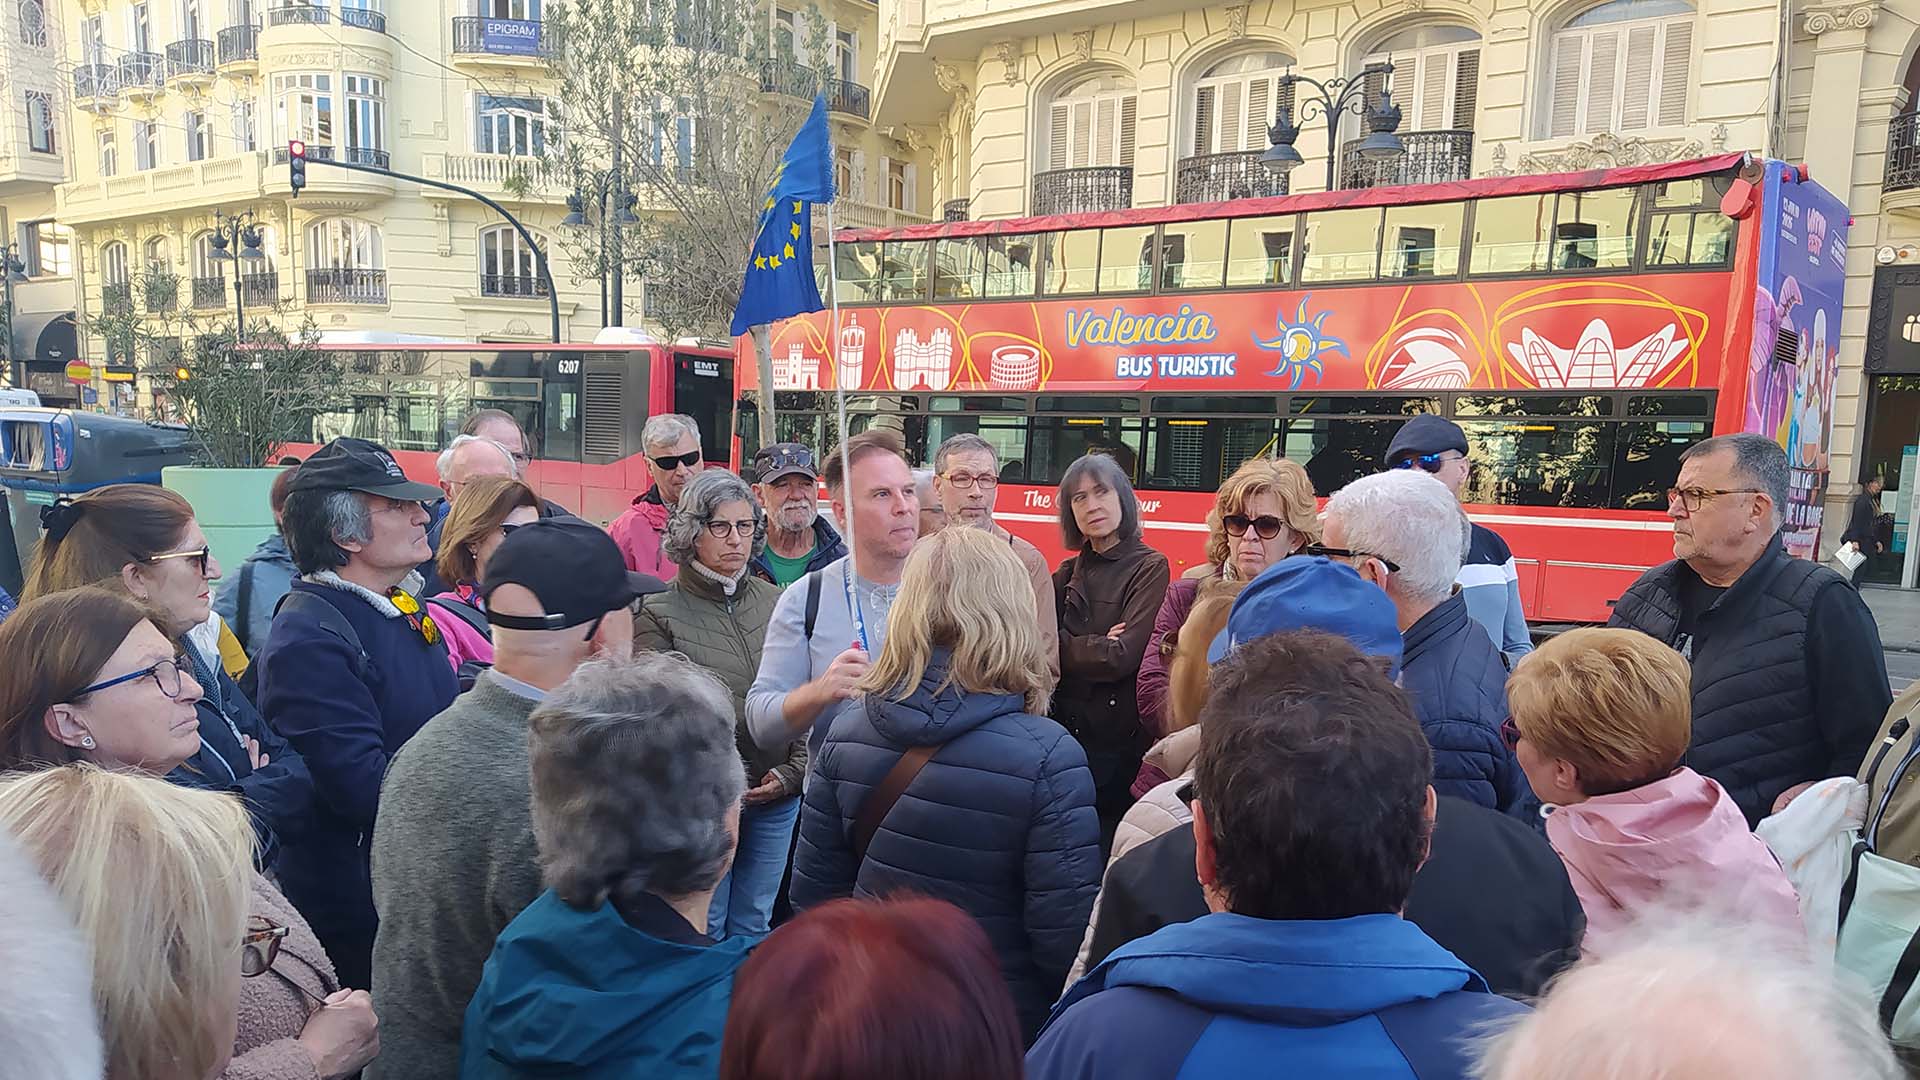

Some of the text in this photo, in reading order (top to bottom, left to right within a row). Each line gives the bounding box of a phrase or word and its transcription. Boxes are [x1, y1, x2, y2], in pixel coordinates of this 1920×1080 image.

[488, 23, 535, 36] EPIGRAM
[1067, 305, 1216, 348] Valencia
[558, 360, 579, 374] 6207
[694, 361, 719, 370] EMT
[1117, 354, 1236, 377] BUS TURISTIC
[1023, 490, 1052, 509] The
